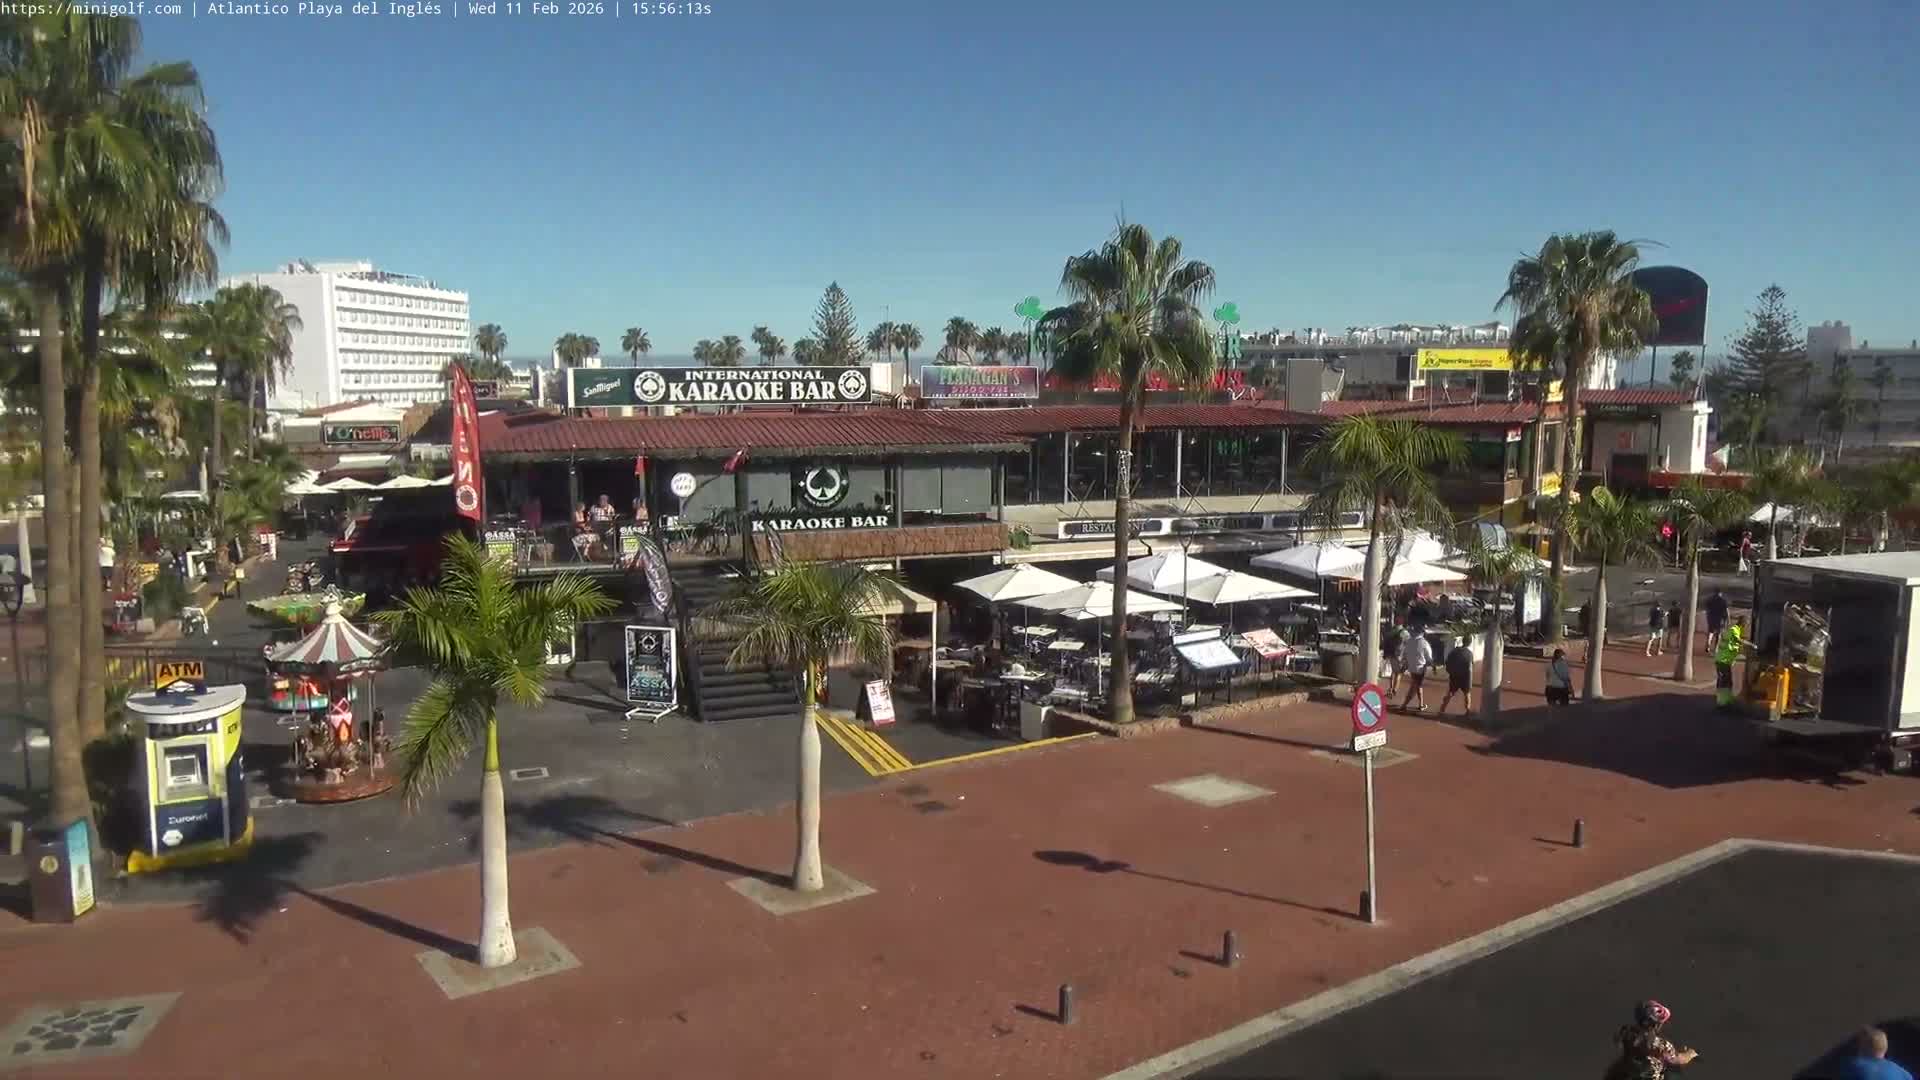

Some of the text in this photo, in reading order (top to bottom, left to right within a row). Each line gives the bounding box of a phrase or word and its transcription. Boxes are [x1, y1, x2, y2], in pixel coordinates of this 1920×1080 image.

[685, 370, 825, 381] INTERNATIONAL
[668, 381, 836, 401] KARAOKE BAR
[752, 515, 889, 532] KARAOKE BAR
[159, 663, 201, 678] ATM
